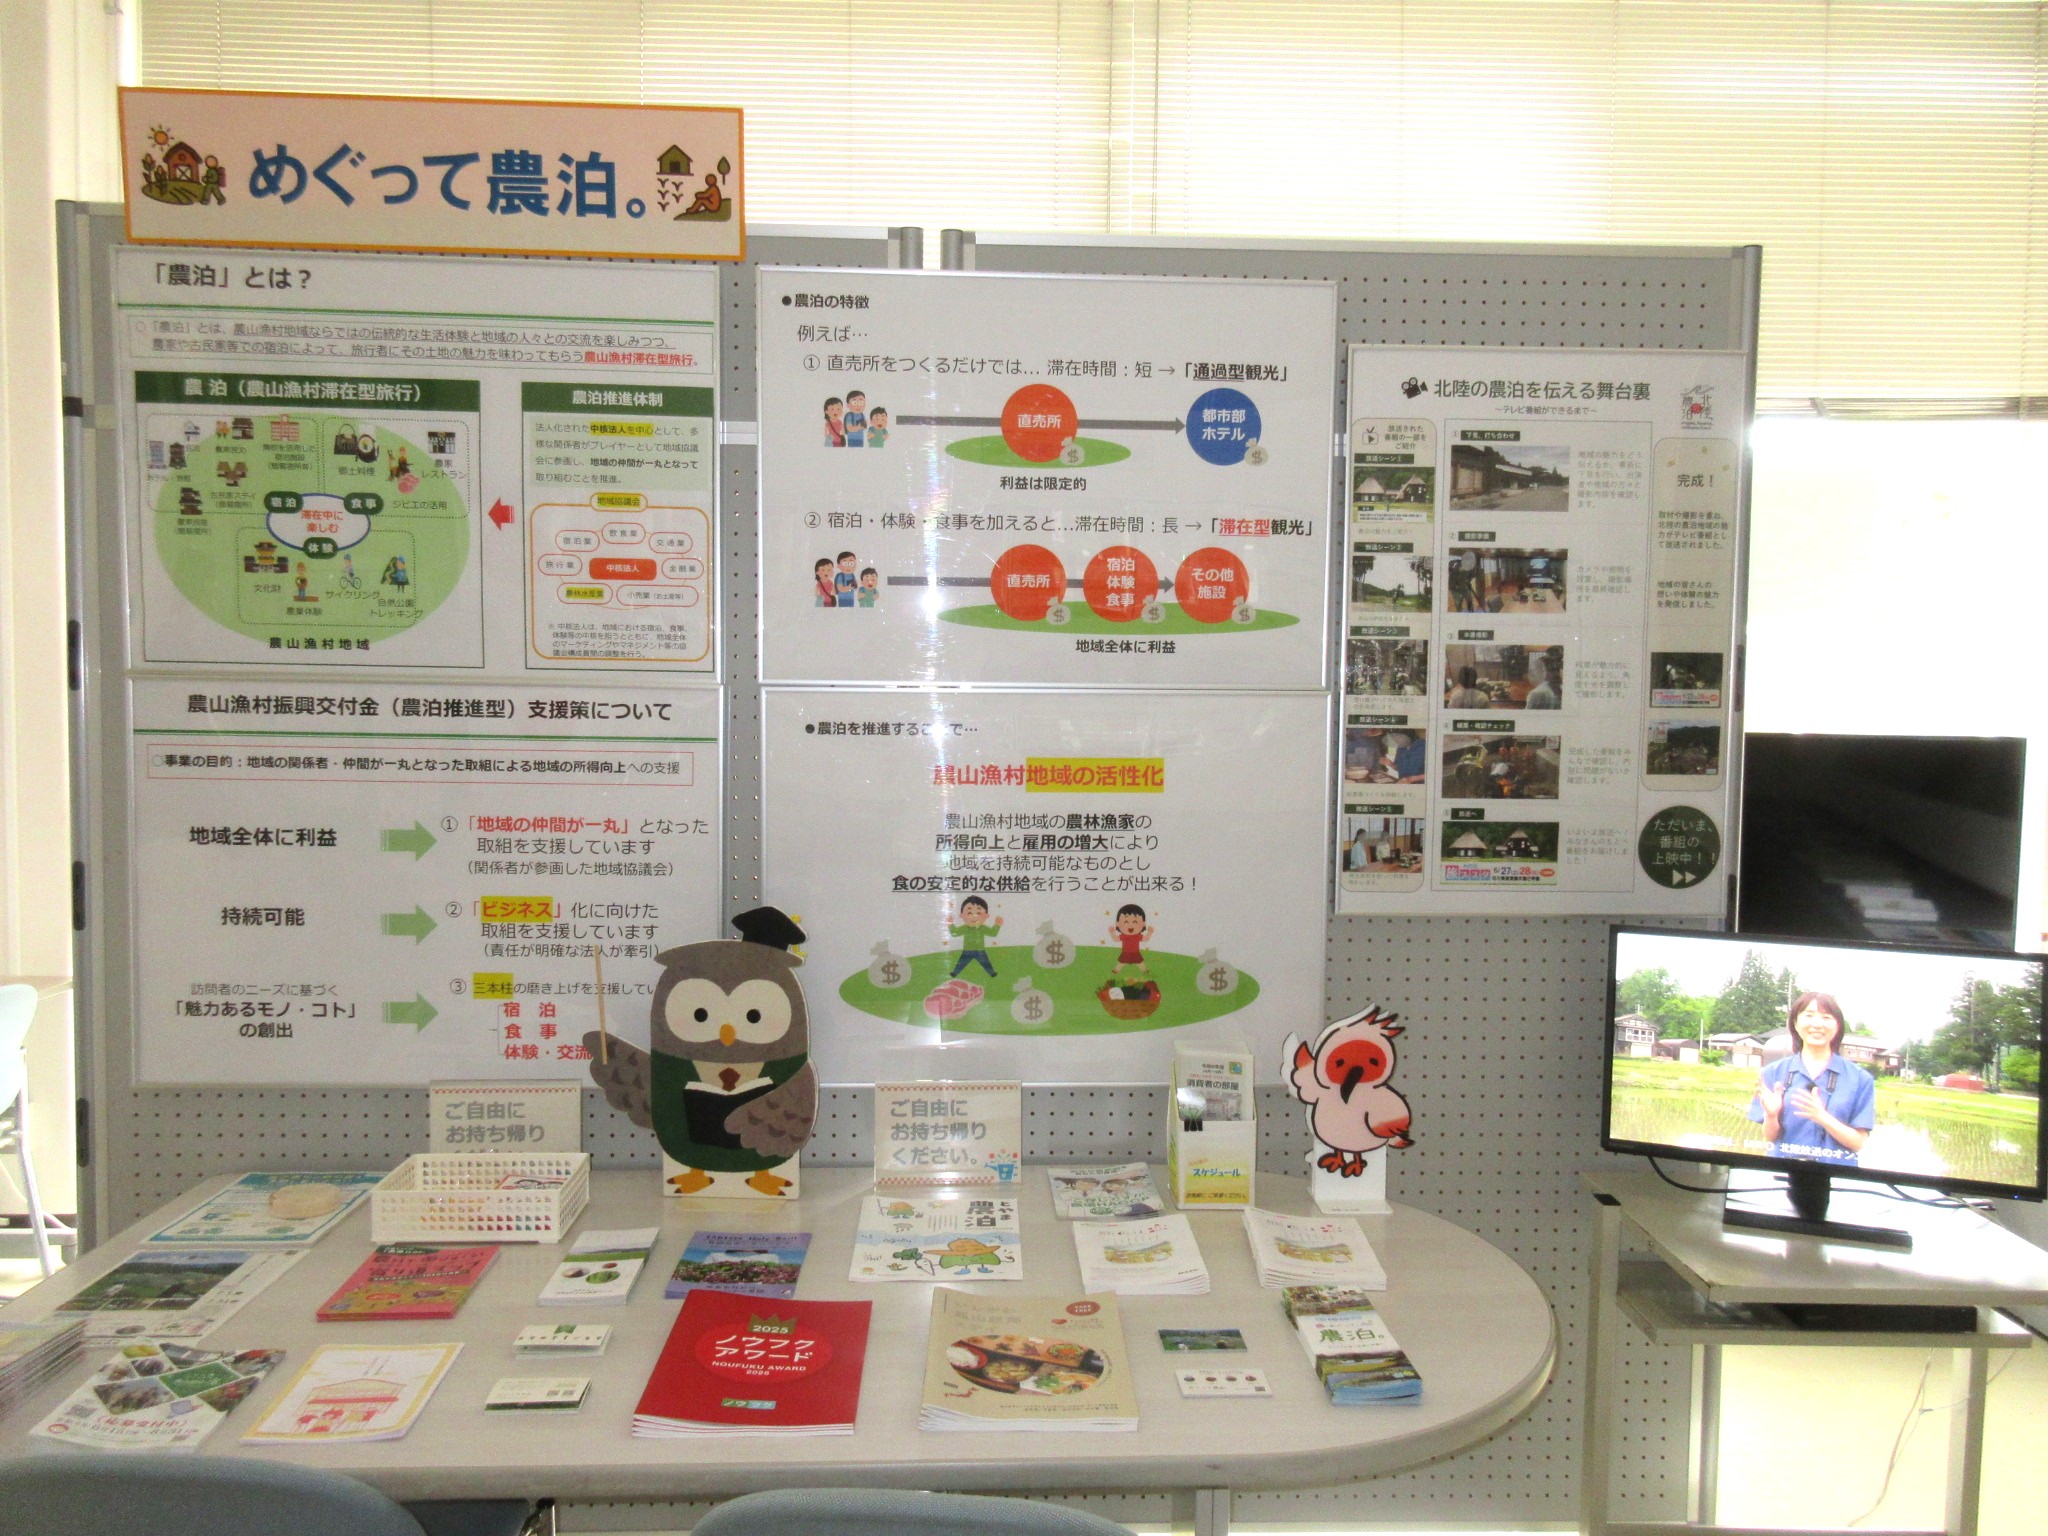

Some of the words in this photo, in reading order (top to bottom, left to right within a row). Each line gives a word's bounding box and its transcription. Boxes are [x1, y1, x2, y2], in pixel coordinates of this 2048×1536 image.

[249, 142, 647, 221] めぐって農泊。
[154, 261, 313, 291] 「農泊」とは？
[794, 292, 870, 310] 農泊の特徴
[797, 324, 869, 344] 例えば…
[803, 354, 821, 372] ①
[1182, 363, 1291, 384] 「通過型観光」
[572, 390, 663, 407] 農泊推進体制
[1434, 379, 1651, 401] 北陸の農泊を伝える舞台裏
[1017, 413, 1063, 430] 直売所
[1201, 408, 1246, 425] 都市部
[535, 423, 699, 437] 法人化された中核法人を中心として、多
[1201, 427, 1246, 443] ホテル
[1384, 433, 1426, 442] 番組の一部を
[1388, 425, 1424, 433] 放送された
[535, 440, 699, 454] 様な関係者がプレイヤーとして地域協議
[1395, 442, 1417, 450] ご紹介
[535, 456, 698, 470] 会に参画し、地域の仲間が一丸となって
[421, 470, 467, 479] レストラン
[535, 472, 622, 484] 取り組むことを推進。
[1677, 474, 1714, 488] 完成！
[1000, 476, 1087, 492] 利益は限定的
[393, 500, 448, 511] ジビエの活用
[301, 509, 343, 522] 滞在中に
[306, 522, 339, 534] 楽しむ
[804, 512, 822, 530] ②
[1208, 517, 1316, 539] 「滞在型観光」
[308, 541, 334, 554] 体験
[606, 564, 640, 573] 中核法人
[1107, 557, 1136, 573] 宿泊
[1007, 573, 1051, 589] 直売所
[1107, 574, 1136, 591] 体験
[1191, 567, 1235, 583] その他
[325, 590, 380, 600] サイクリング
[1106, 592, 1135, 608] 食事
[1198, 584, 1227, 600] 施設
[378, 598, 415, 608] 自然公園
[369, 609, 423, 619] トレッキング
[269, 637, 370, 651] 農山漁村地域
[1076, 639, 1176, 655] 地域全体に利益
[187, 694, 673, 724] 農山漁村振興交付金（農泊推進型）支援策について
[817, 721, 979, 737] 農泊を推進するこで…
[933, 765, 1164, 788] 農山漁村地域の活性化
[441, 815, 459, 834] ①
[467, 815, 710, 838] 「地域の仲間が一丸」となった
[946, 813, 1152, 832] 農山漁村地域の農林漁家の
[1653, 818, 1714, 832] ただいま、
[189, 826, 338, 848] 地域全体に利益
[935, 833, 1160, 852] 所得向上と雇用の増大により
[1659, 835, 1700, 849] 番組の
[477, 837, 656, 857] 取組を支援しています
[466, 859, 677, 880] （関係者が参画した地域協議会）
[946, 854, 1152, 872] 地域を持続可能なものとし
[892, 875, 1198, 893] 食の安定的な供給を行うことが出来る！
[221, 906, 305, 928] 持続可能
[445, 900, 463, 919] ②
[471, 899, 660, 921] 「ビジネス」化に向けた
[480, 921, 660, 941] 取組を支援しています
[190, 981, 338, 998] 訪問者のニーズに基づく
[449, 977, 467, 996] ③
[174, 1000, 358, 1021] 「魅力あるモノ・コト」
[239, 1022, 294, 1040] の創出
[504, 1043, 594, 1060] 体験・交流
[1186, 1078, 1240, 1091] 消費者の部屋
[445, 1101, 527, 1120] ご自由に
[890, 1099, 968, 1118] ご自由に
[445, 1124, 546, 1144] お持ち帰り
[890, 1122, 987, 1142] お持ち帰り
[891, 1146, 979, 1167] ください。
[1192, 1168, 1241, 1178] スケジュール
[964, 1200, 997, 1227] 農泊
[752, 1324, 789, 1334] 2025
[715, 1335, 816, 1350] ノウフク
[714, 1346, 814, 1363] アワード
[711, 1360, 765, 1370] NOUFUKU
